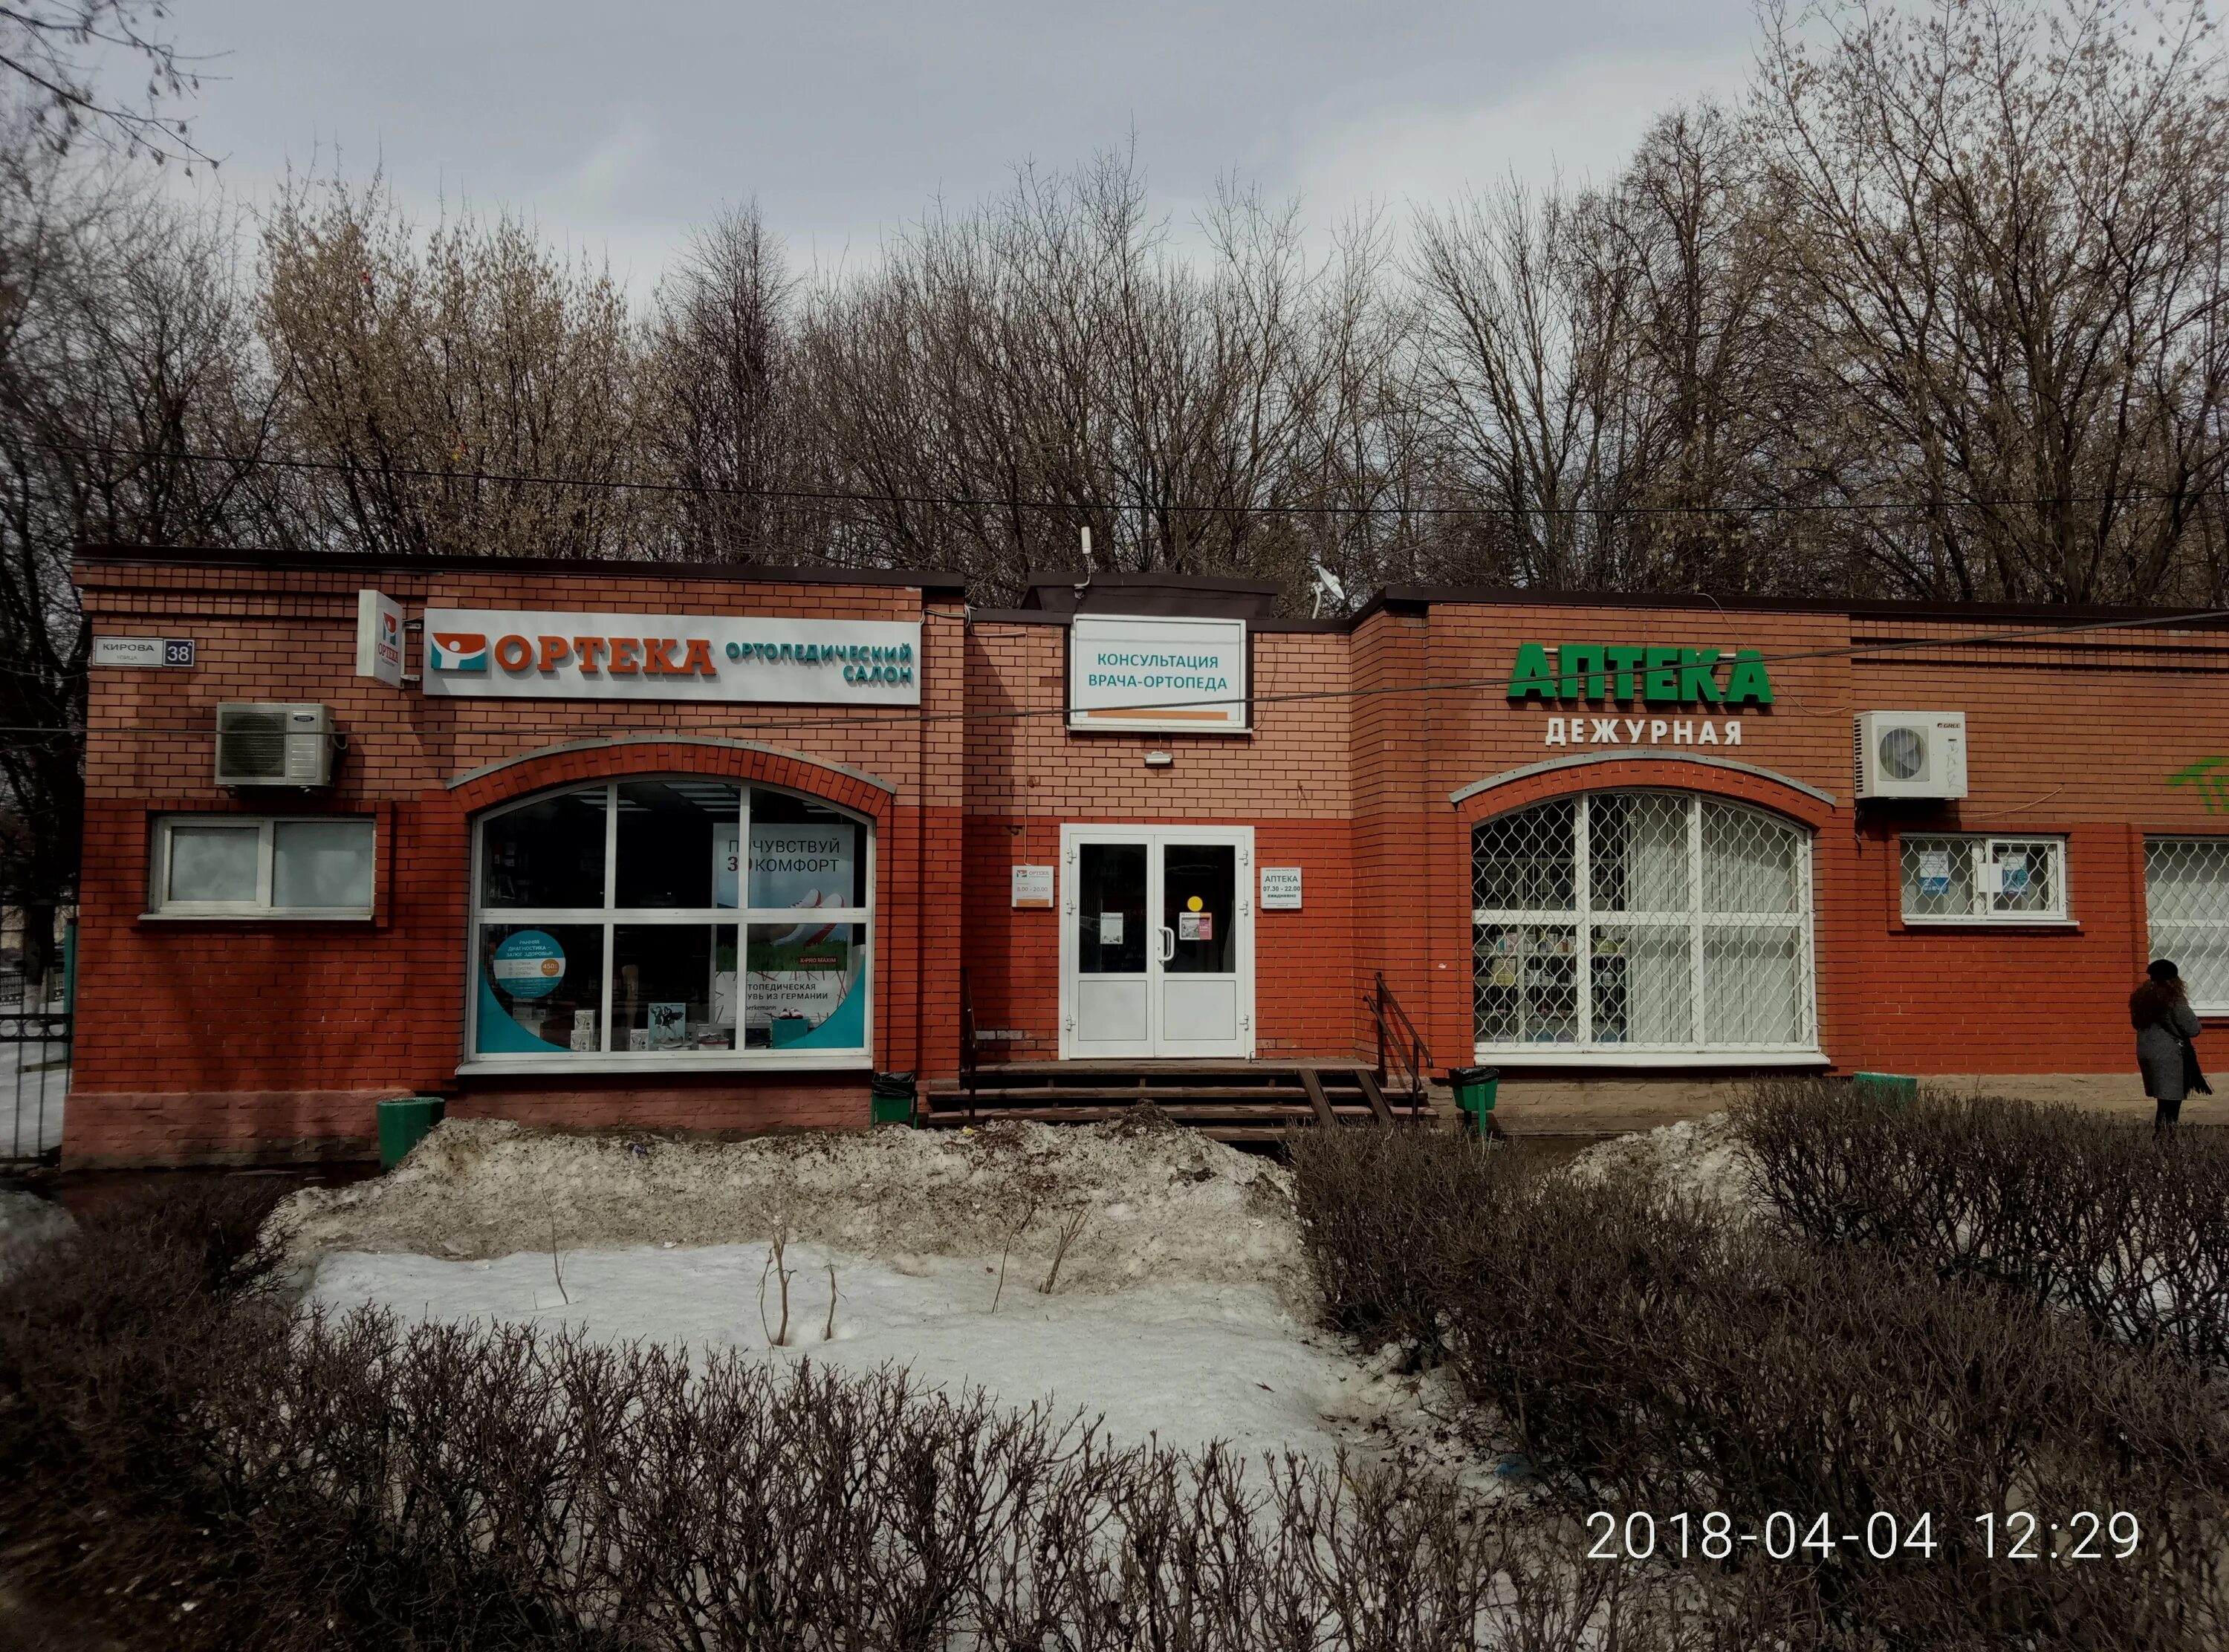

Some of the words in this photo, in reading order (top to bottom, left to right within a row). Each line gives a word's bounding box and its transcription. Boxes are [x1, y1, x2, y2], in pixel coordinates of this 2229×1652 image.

[103, 643, 155, 651] КИРОВА
[495, 634, 717, 675] ОРТЕКА
[726, 643, 912, 663] ОРТОПЕДИЧЕСКИЙ
[1097, 654, 1219, 670] КОНСУЛЬТАЦИЯ
[843, 666, 912, 683] САЛОН
[1088, 674, 1227, 692] ВРАЧА-ОРТОПЕДА
[1506, 643, 1775, 706] АПТЕКА
[1545, 718, 1742, 747] ДЕЖУРНАЯ
[729, 838, 840, 853] ПЧУВСТВУЙ
[727, 856, 753, 872] 3
[755, 859, 840, 872] КОМФОРТ
